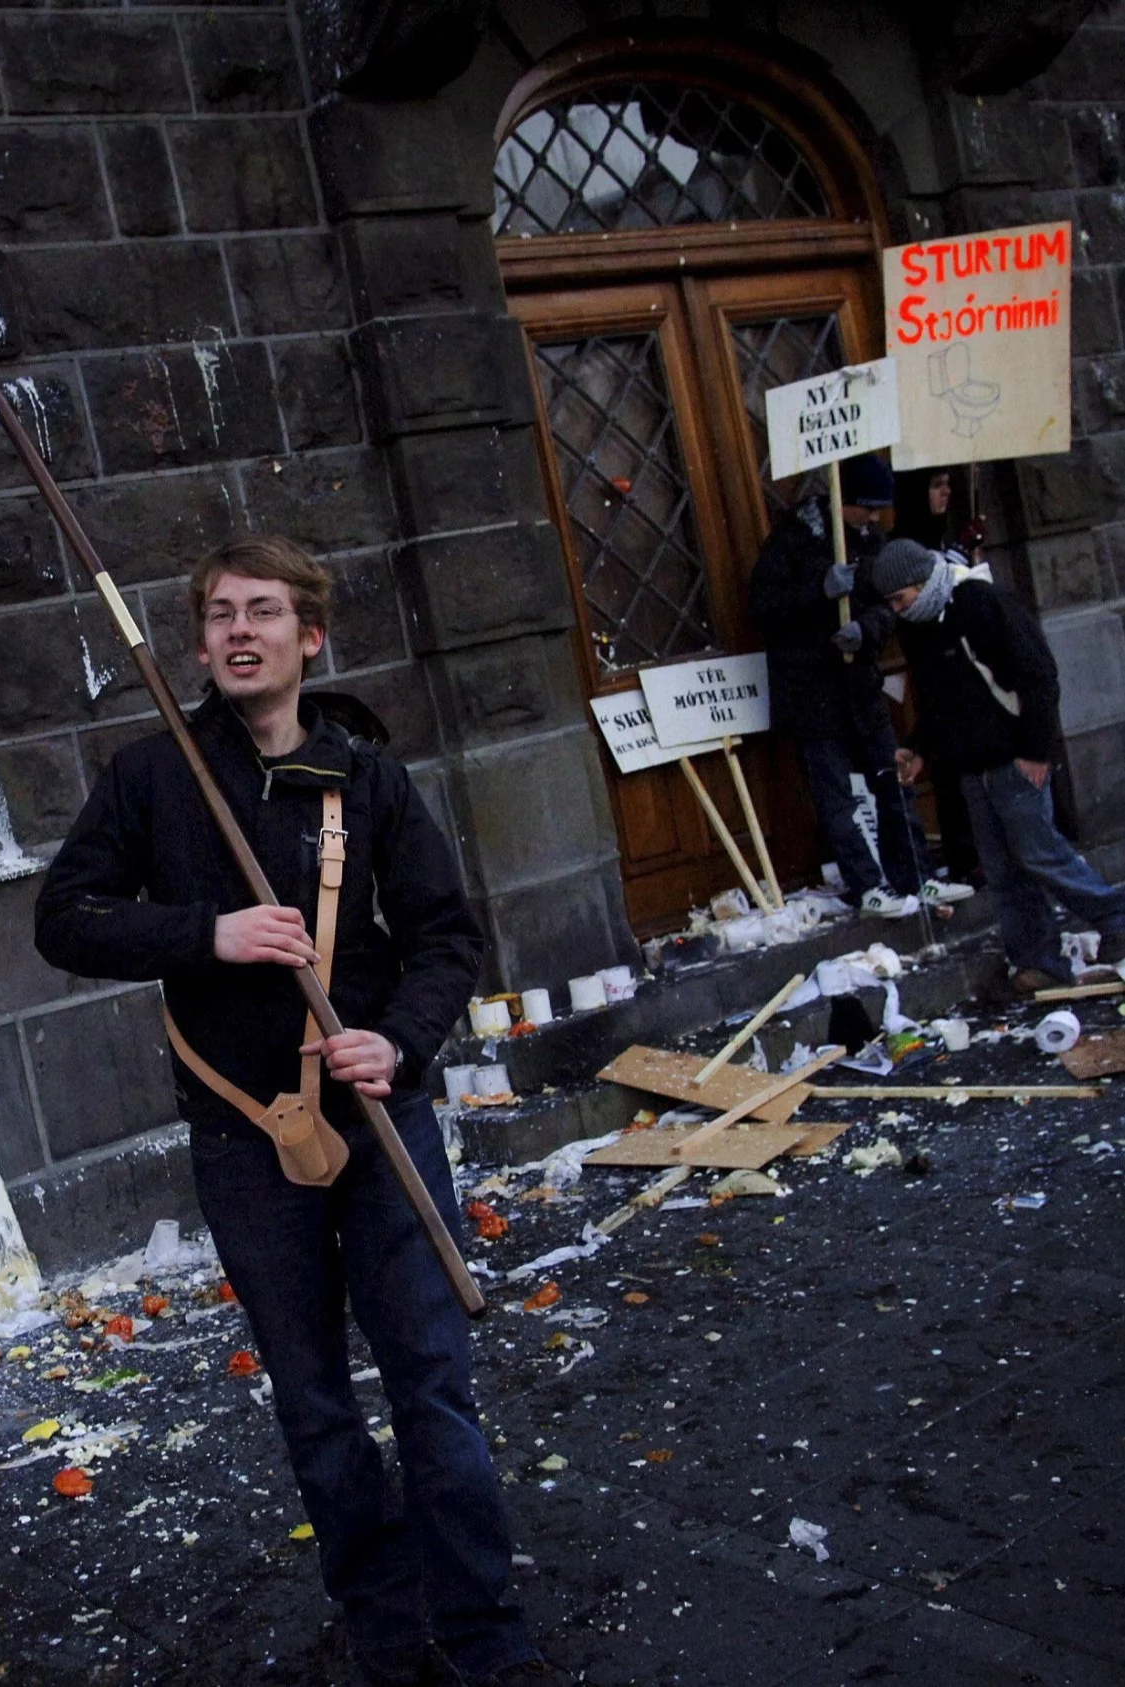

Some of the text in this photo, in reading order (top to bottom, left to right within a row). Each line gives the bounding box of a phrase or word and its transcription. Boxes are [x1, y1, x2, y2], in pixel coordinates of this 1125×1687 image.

[901, 228, 1066, 287] STURTUM
[804, 428, 857, 458] NÚNA!
[673, 683, 758, 710] MÓTMÆLUM
[710, 706, 736, 724] ÖLL
